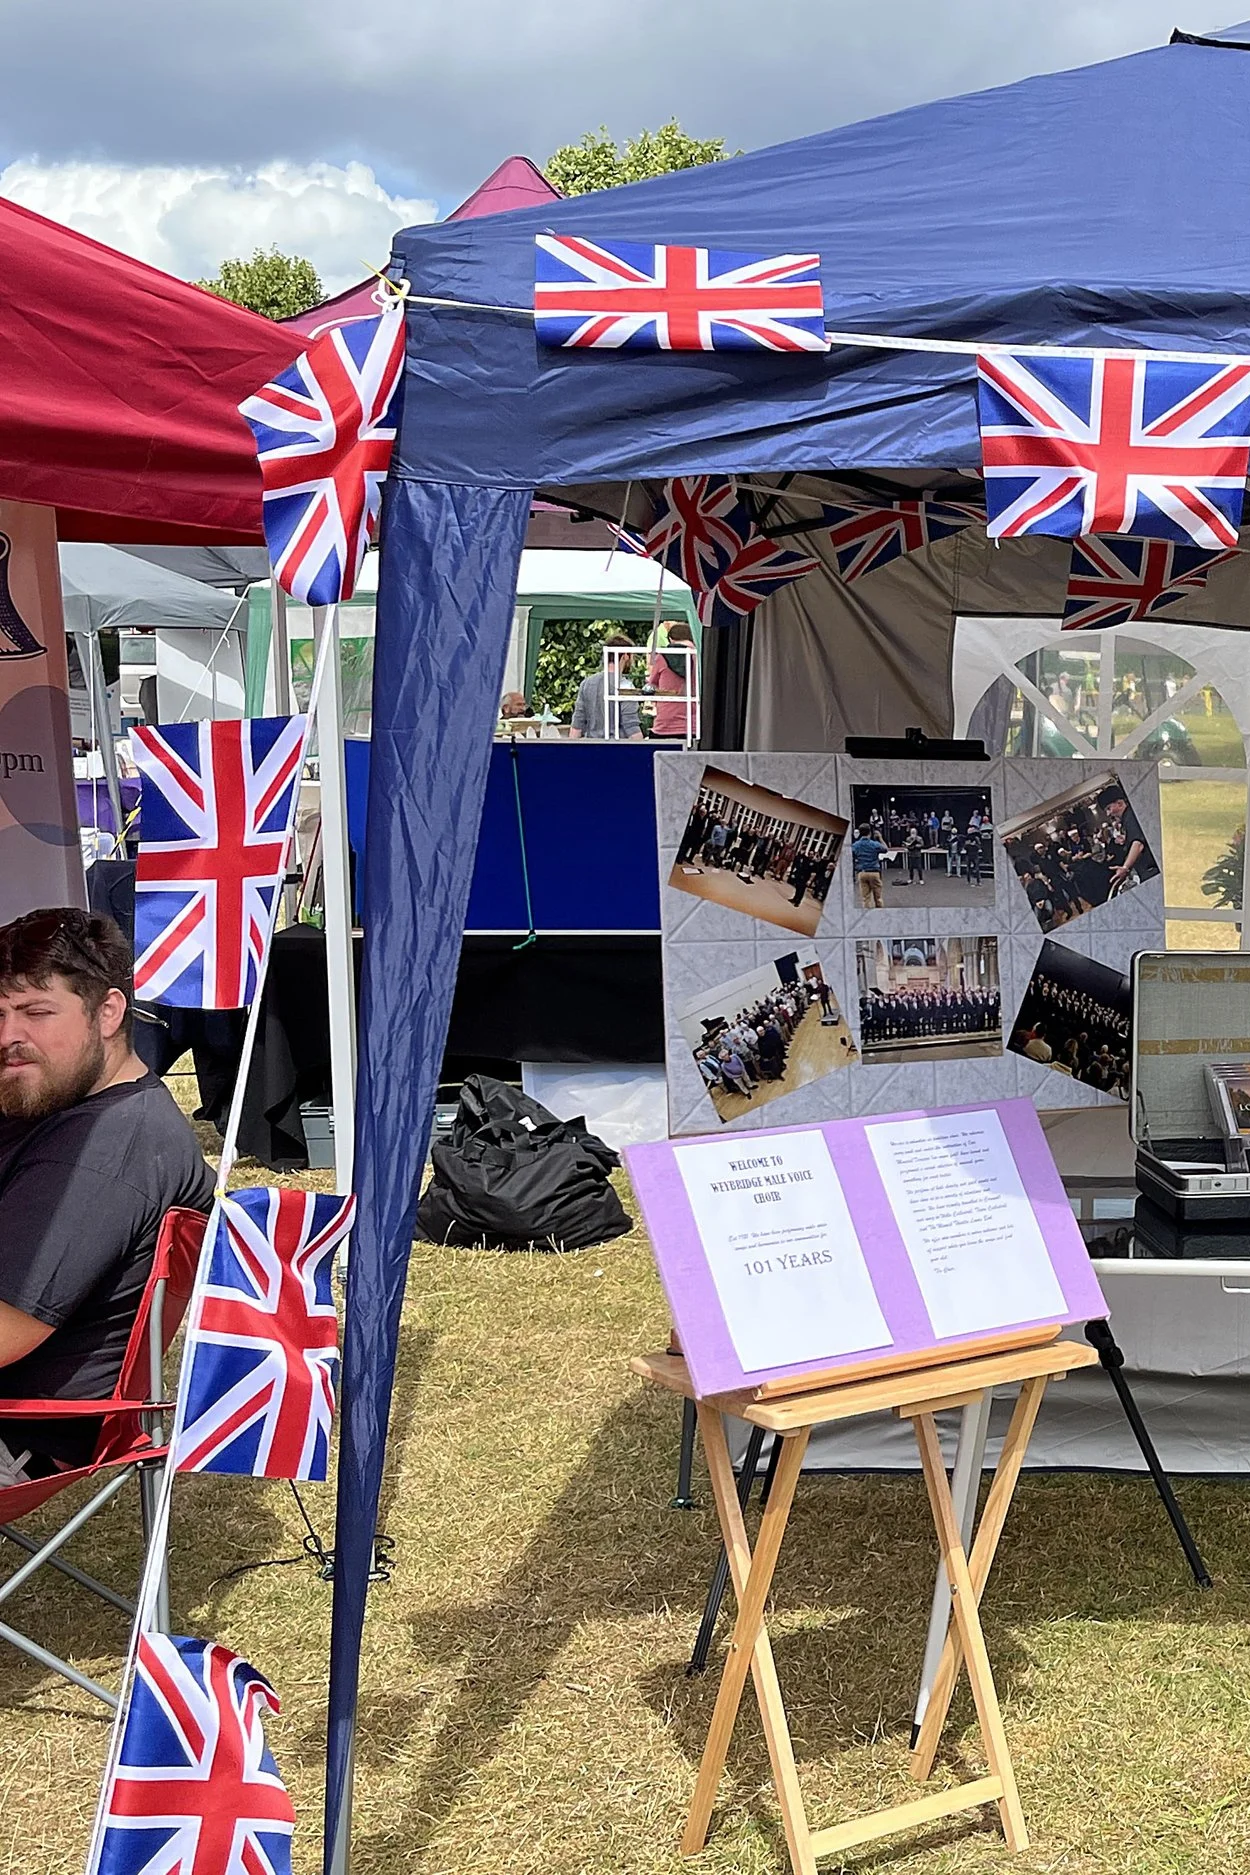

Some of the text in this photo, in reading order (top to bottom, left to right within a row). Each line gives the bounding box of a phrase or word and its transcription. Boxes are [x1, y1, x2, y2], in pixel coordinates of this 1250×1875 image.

[0, 753, 45, 779] pm
[728, 1155, 783, 1171] WELCOME TO
[710, 1170, 814, 1193] WEYBRIDGE MALE VOICE
[754, 1191, 781, 1204] CHOIR
[744, 1250, 833, 1276] 101 YEARS
